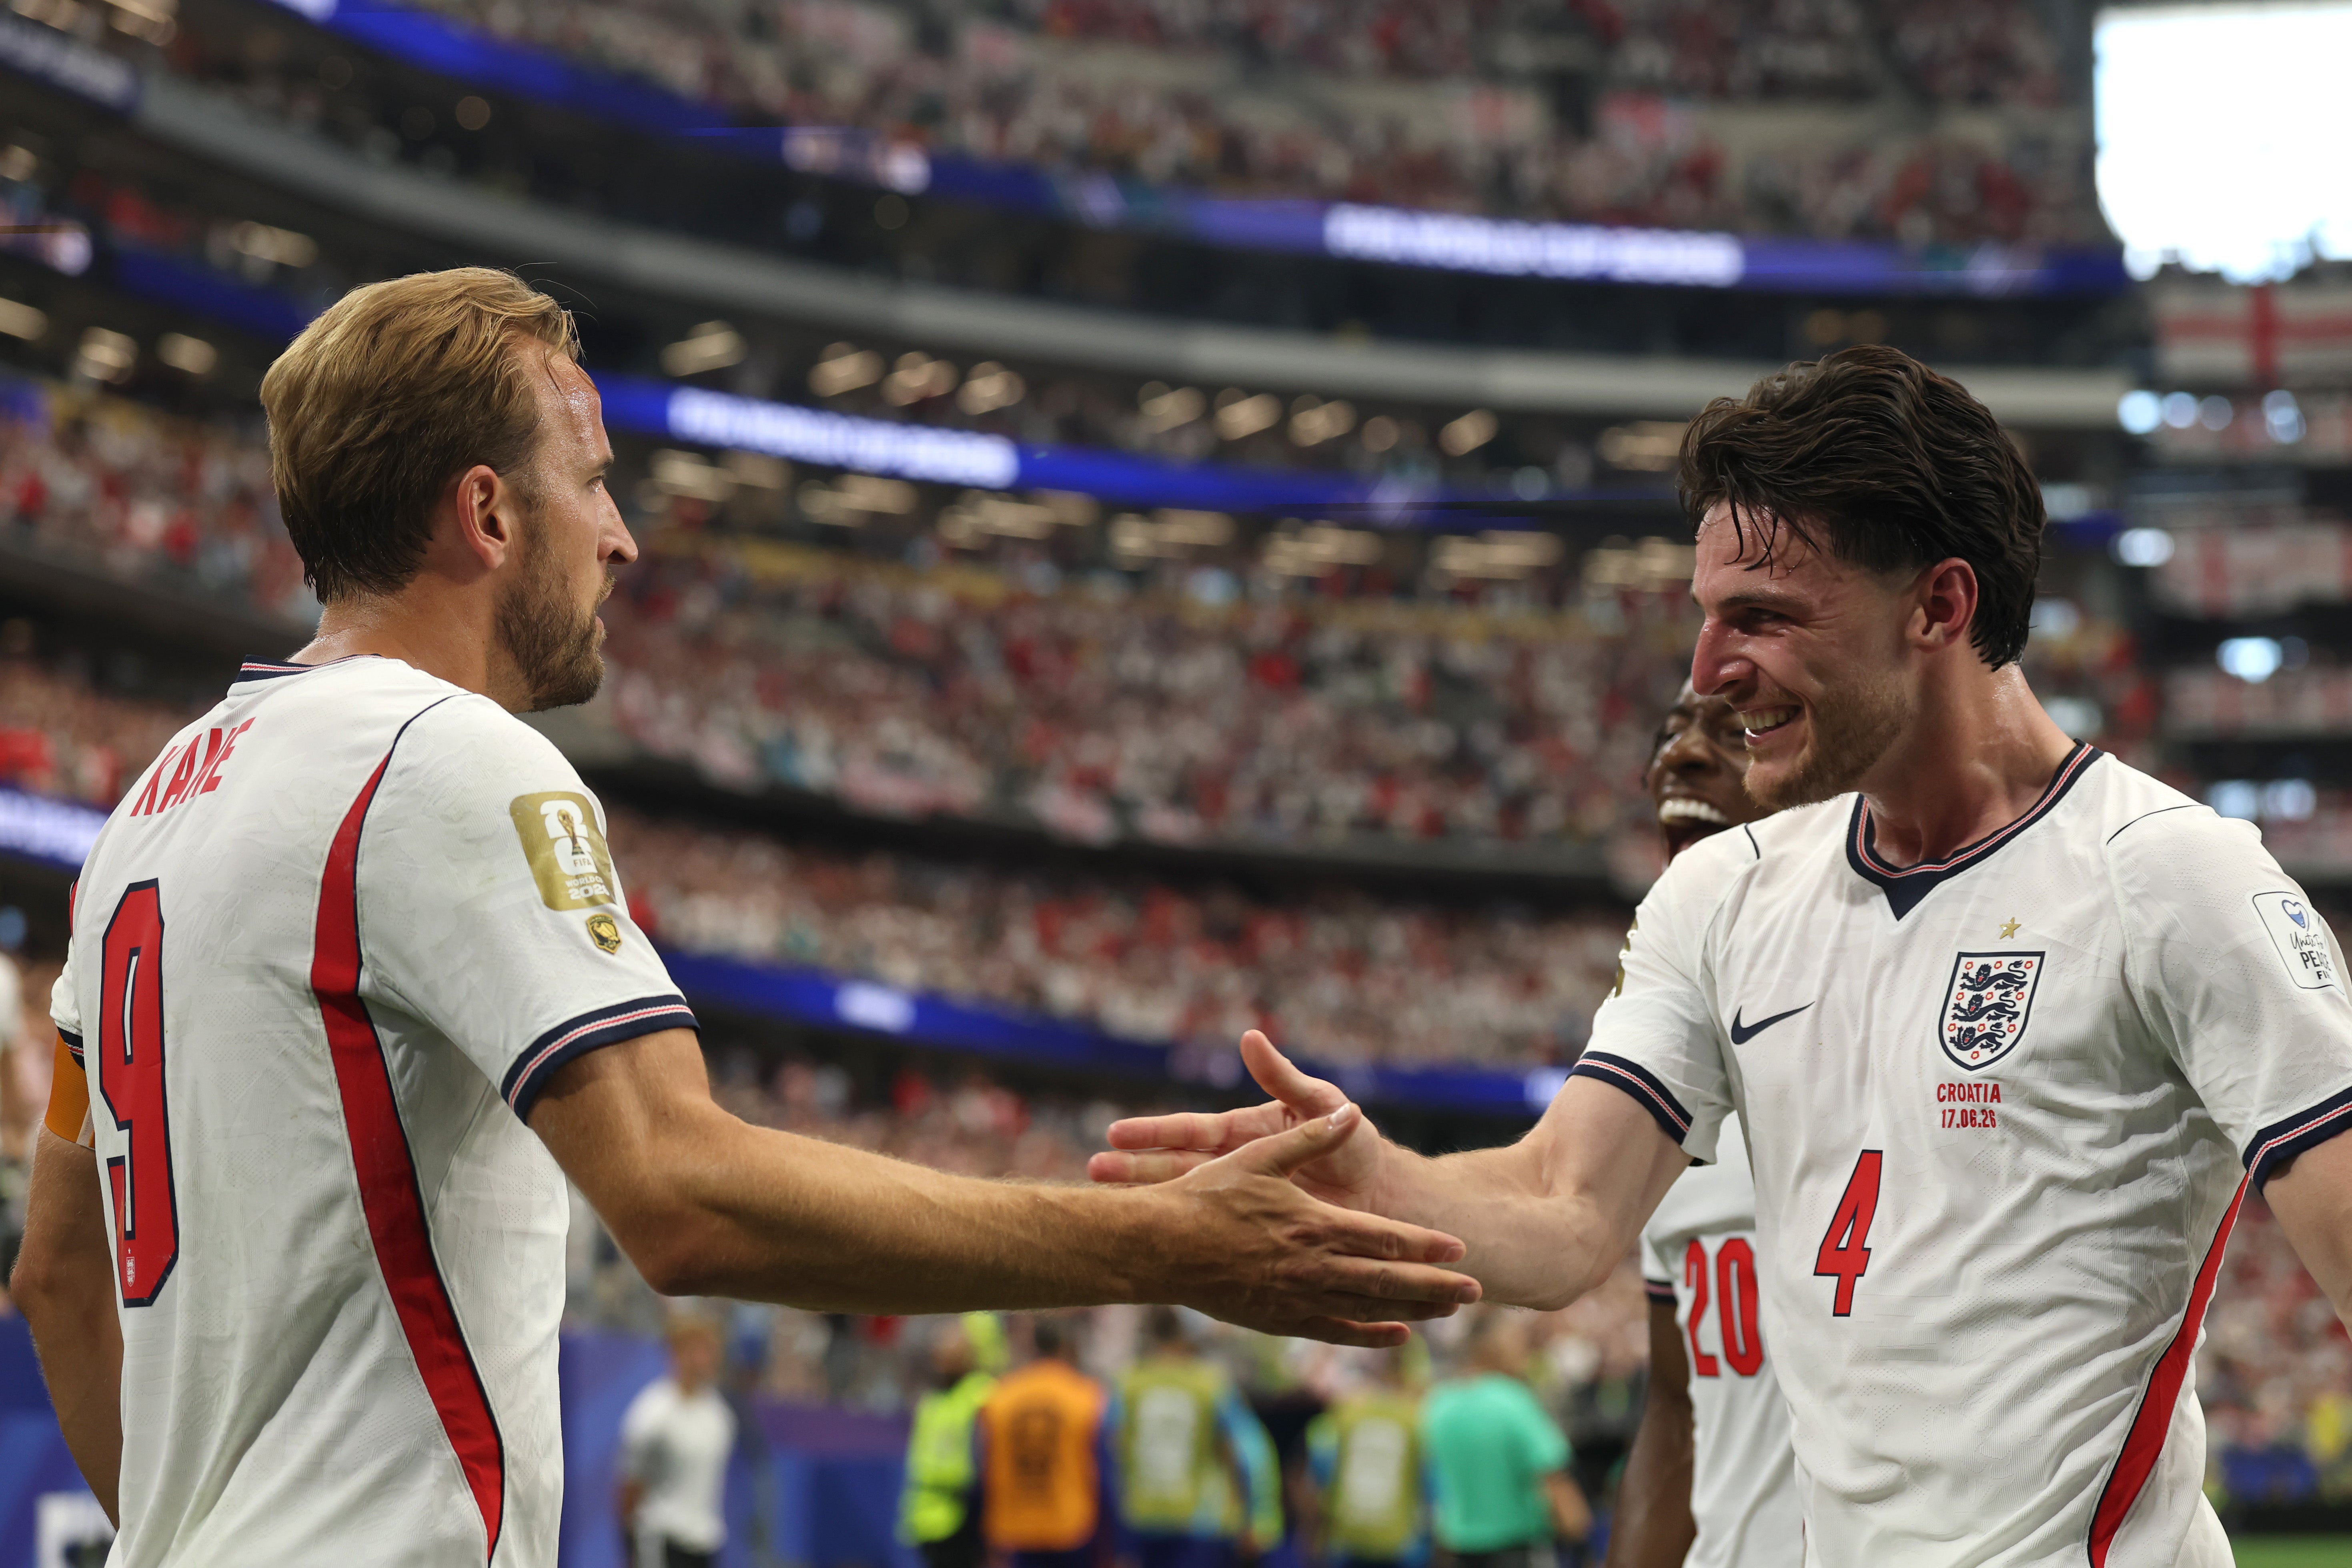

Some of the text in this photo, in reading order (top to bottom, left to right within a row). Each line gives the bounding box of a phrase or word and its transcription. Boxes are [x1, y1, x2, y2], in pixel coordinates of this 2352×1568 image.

[130, 717, 256, 817] KANE
[573, 858, 592, 867] FIFA
[565, 876, 595, 887] WORLD
[2290, 931, 2315, 951] Unite
[100, 877, 178, 1308] 9
[1937, 1083, 2001, 1103] CROATIA
[1942, 1109, 1996, 1128] 17.06.26
[1813, 1149, 1883, 1317] 4
[1685, 1238, 1764, 1377] 20
